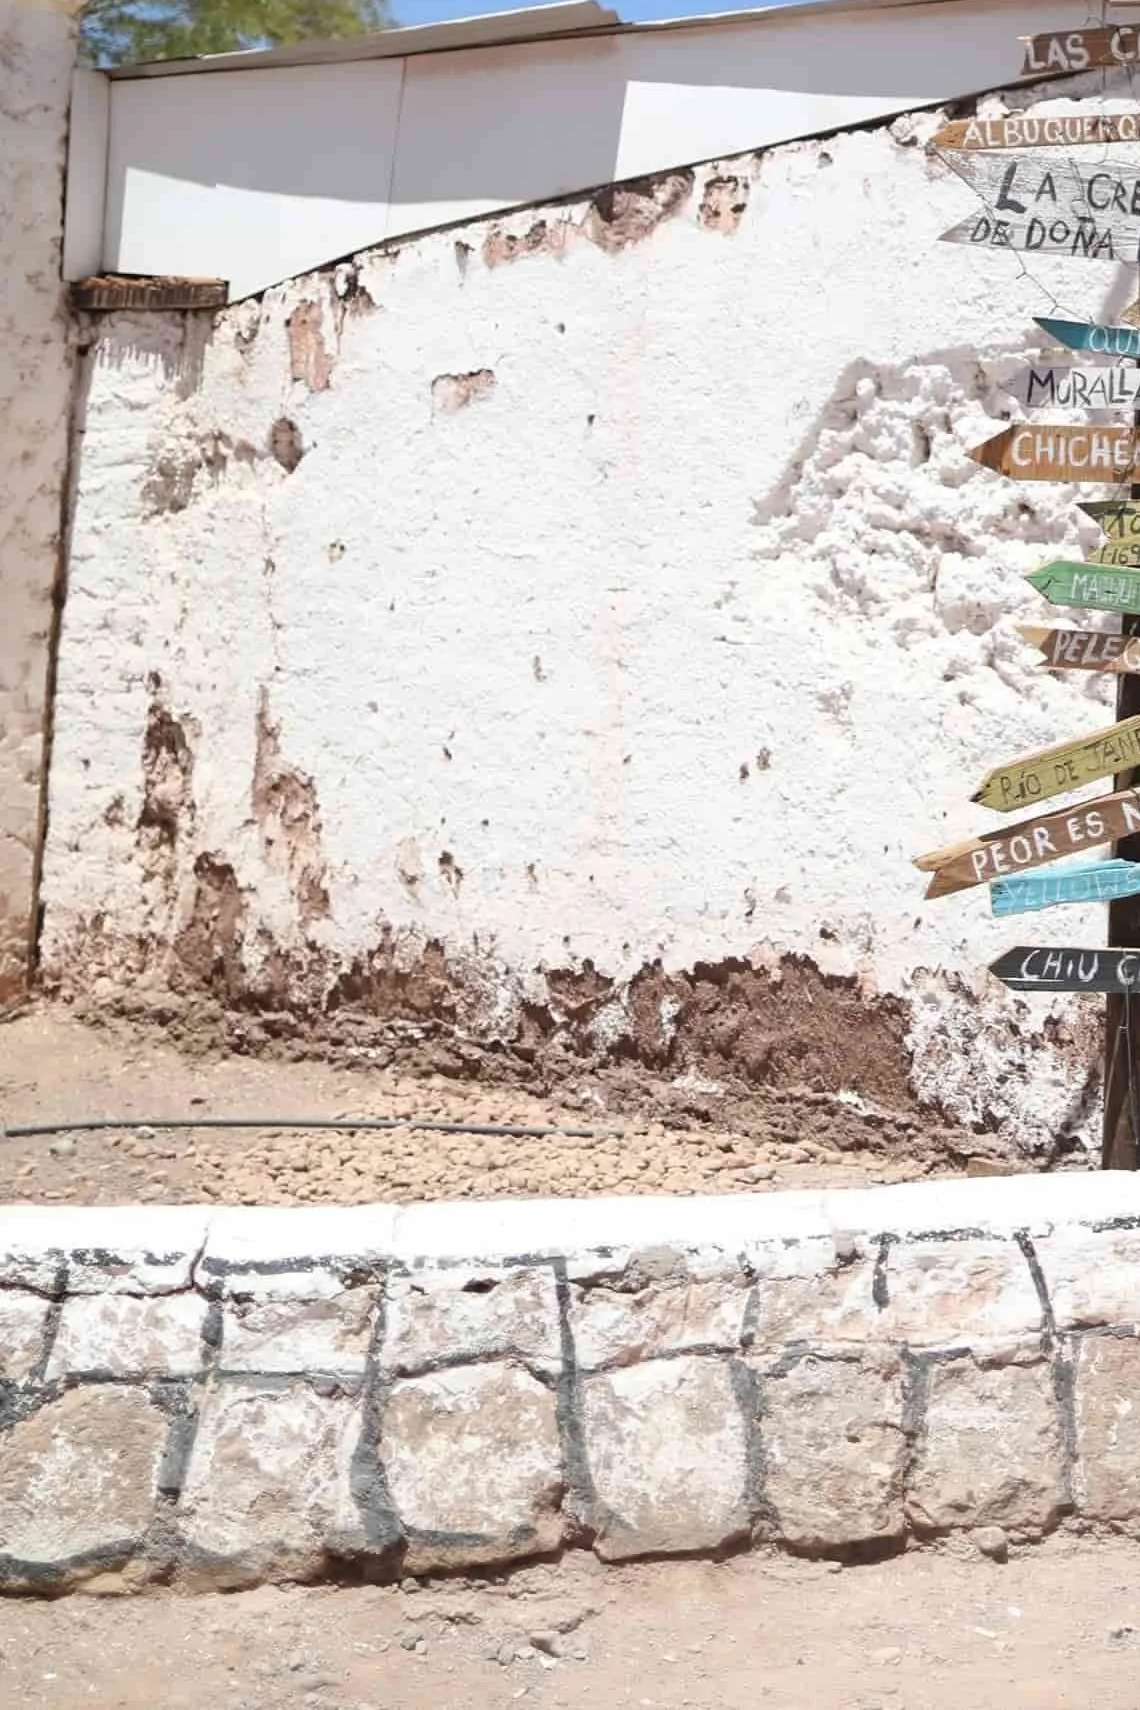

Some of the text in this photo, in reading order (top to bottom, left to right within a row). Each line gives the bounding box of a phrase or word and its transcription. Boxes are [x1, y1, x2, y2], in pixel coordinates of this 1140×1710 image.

[1026, 34, 1090, 70] LAS
[995, 161, 1057, 214] LA
[970, 216, 1009, 247] DE
[1026, 216, 1114, 259] DOÑA
[1054, 759, 1079, 786] DE
[970, 827, 1060, 880] PEOR
[1068, 809, 1105, 844] ES
